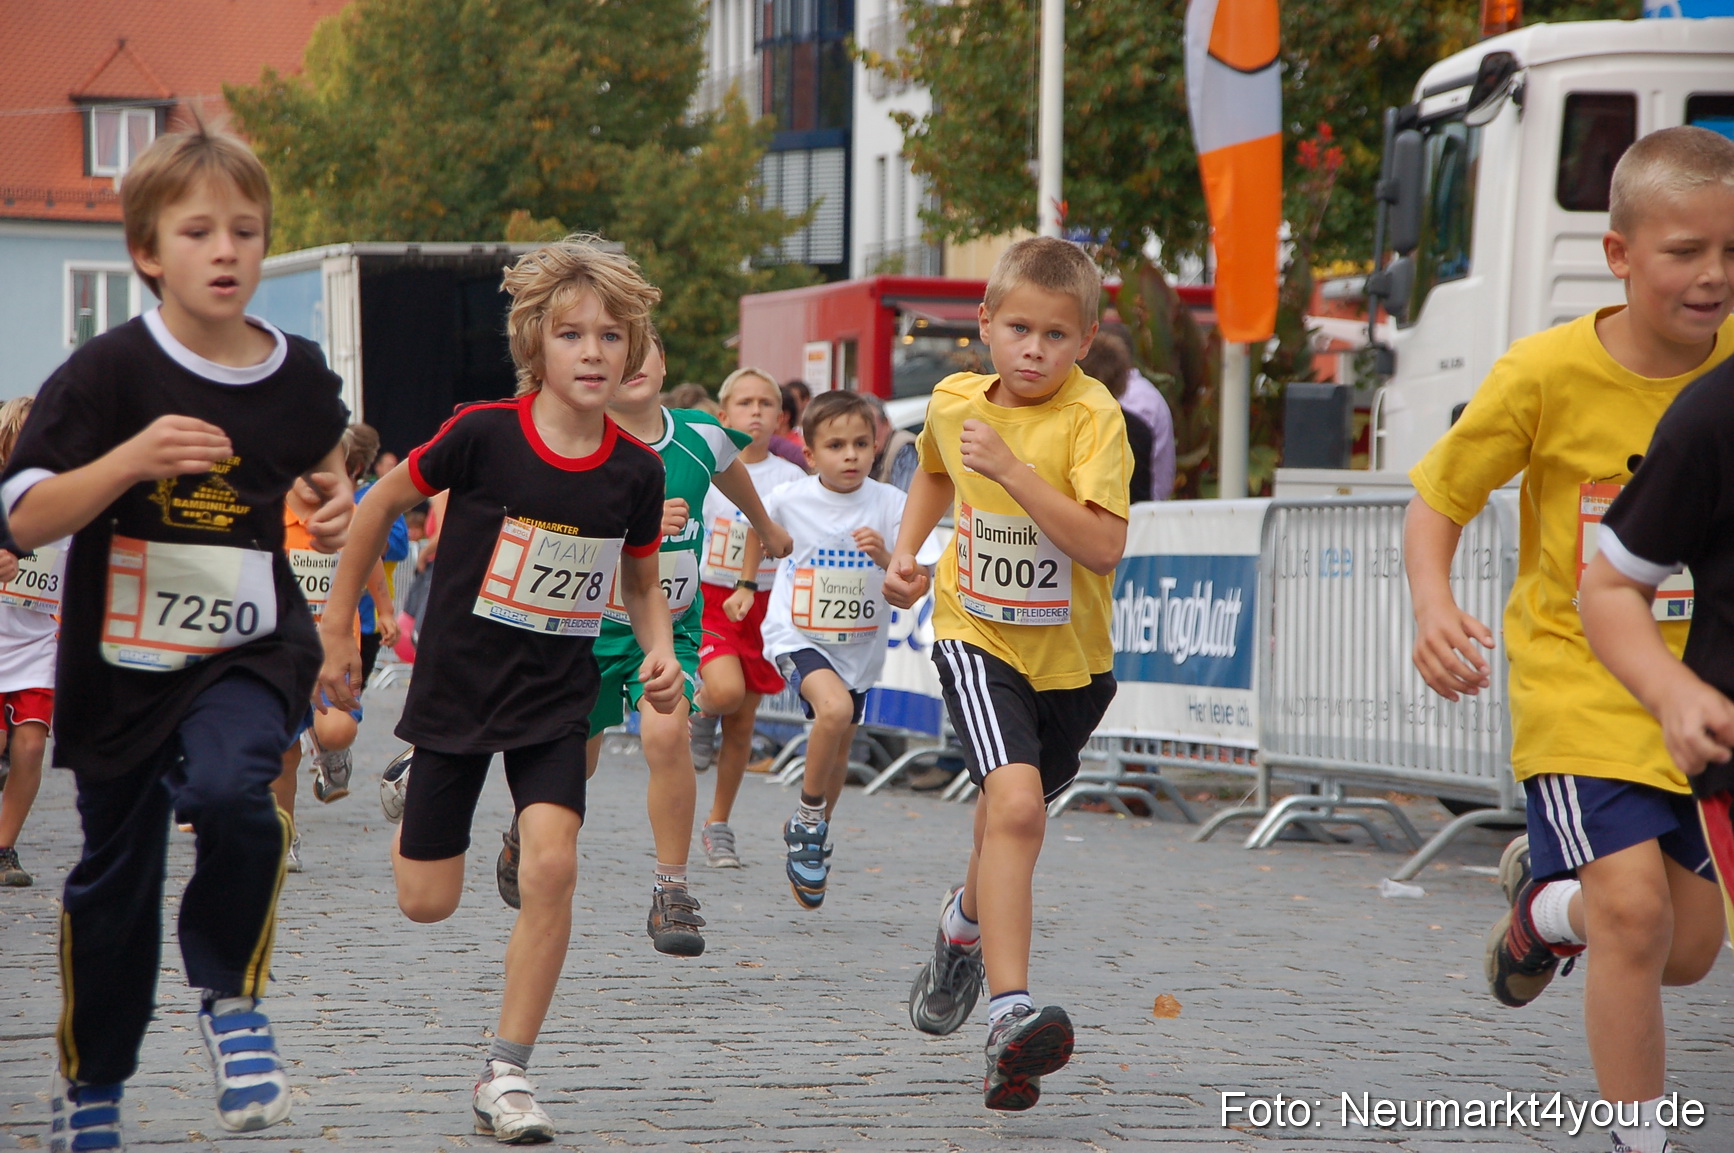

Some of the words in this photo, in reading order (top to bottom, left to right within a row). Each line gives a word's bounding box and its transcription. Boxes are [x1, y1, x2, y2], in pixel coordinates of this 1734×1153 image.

[172, 498, 252, 514] BAMBINILAUF
[519, 516, 579, 535] NEUMARKTER
[976, 518, 1038, 546] Dominik
[538, 536, 598, 564] MAXI
[15, 568, 59, 592] 7063
[529, 564, 604, 601] 7278
[977, 553, 1058, 589] 7002
[294, 575, 333, 593] 706
[660, 577, 689, 600] 67
[820, 577, 865, 596] Yannick
[157, 591, 260, 636] 7250
[819, 599, 875, 619] 7296
[1016, 608, 1069, 618] PFLEIDERER
[560, 618, 599, 628] PFLEIDERER
[1159, 577, 1243, 666] Tagblatt
